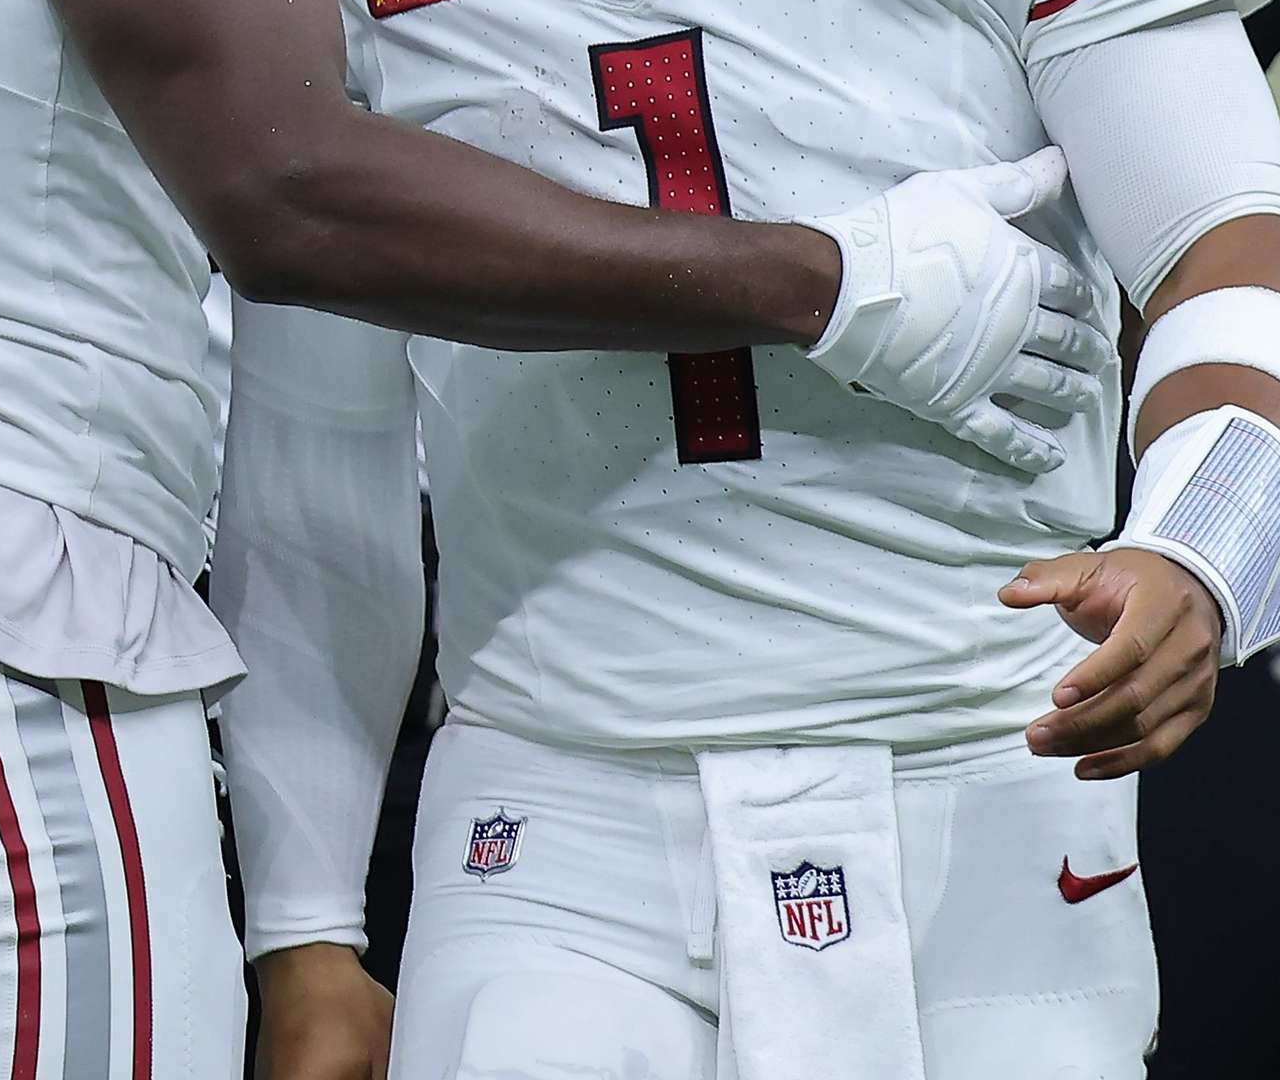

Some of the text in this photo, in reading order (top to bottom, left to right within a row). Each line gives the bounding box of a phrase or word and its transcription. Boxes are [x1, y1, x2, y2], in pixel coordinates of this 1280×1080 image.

[588, 26, 762, 463] 1
[470, 839, 508, 867] NFL
[783, 900, 843, 941] NFL
